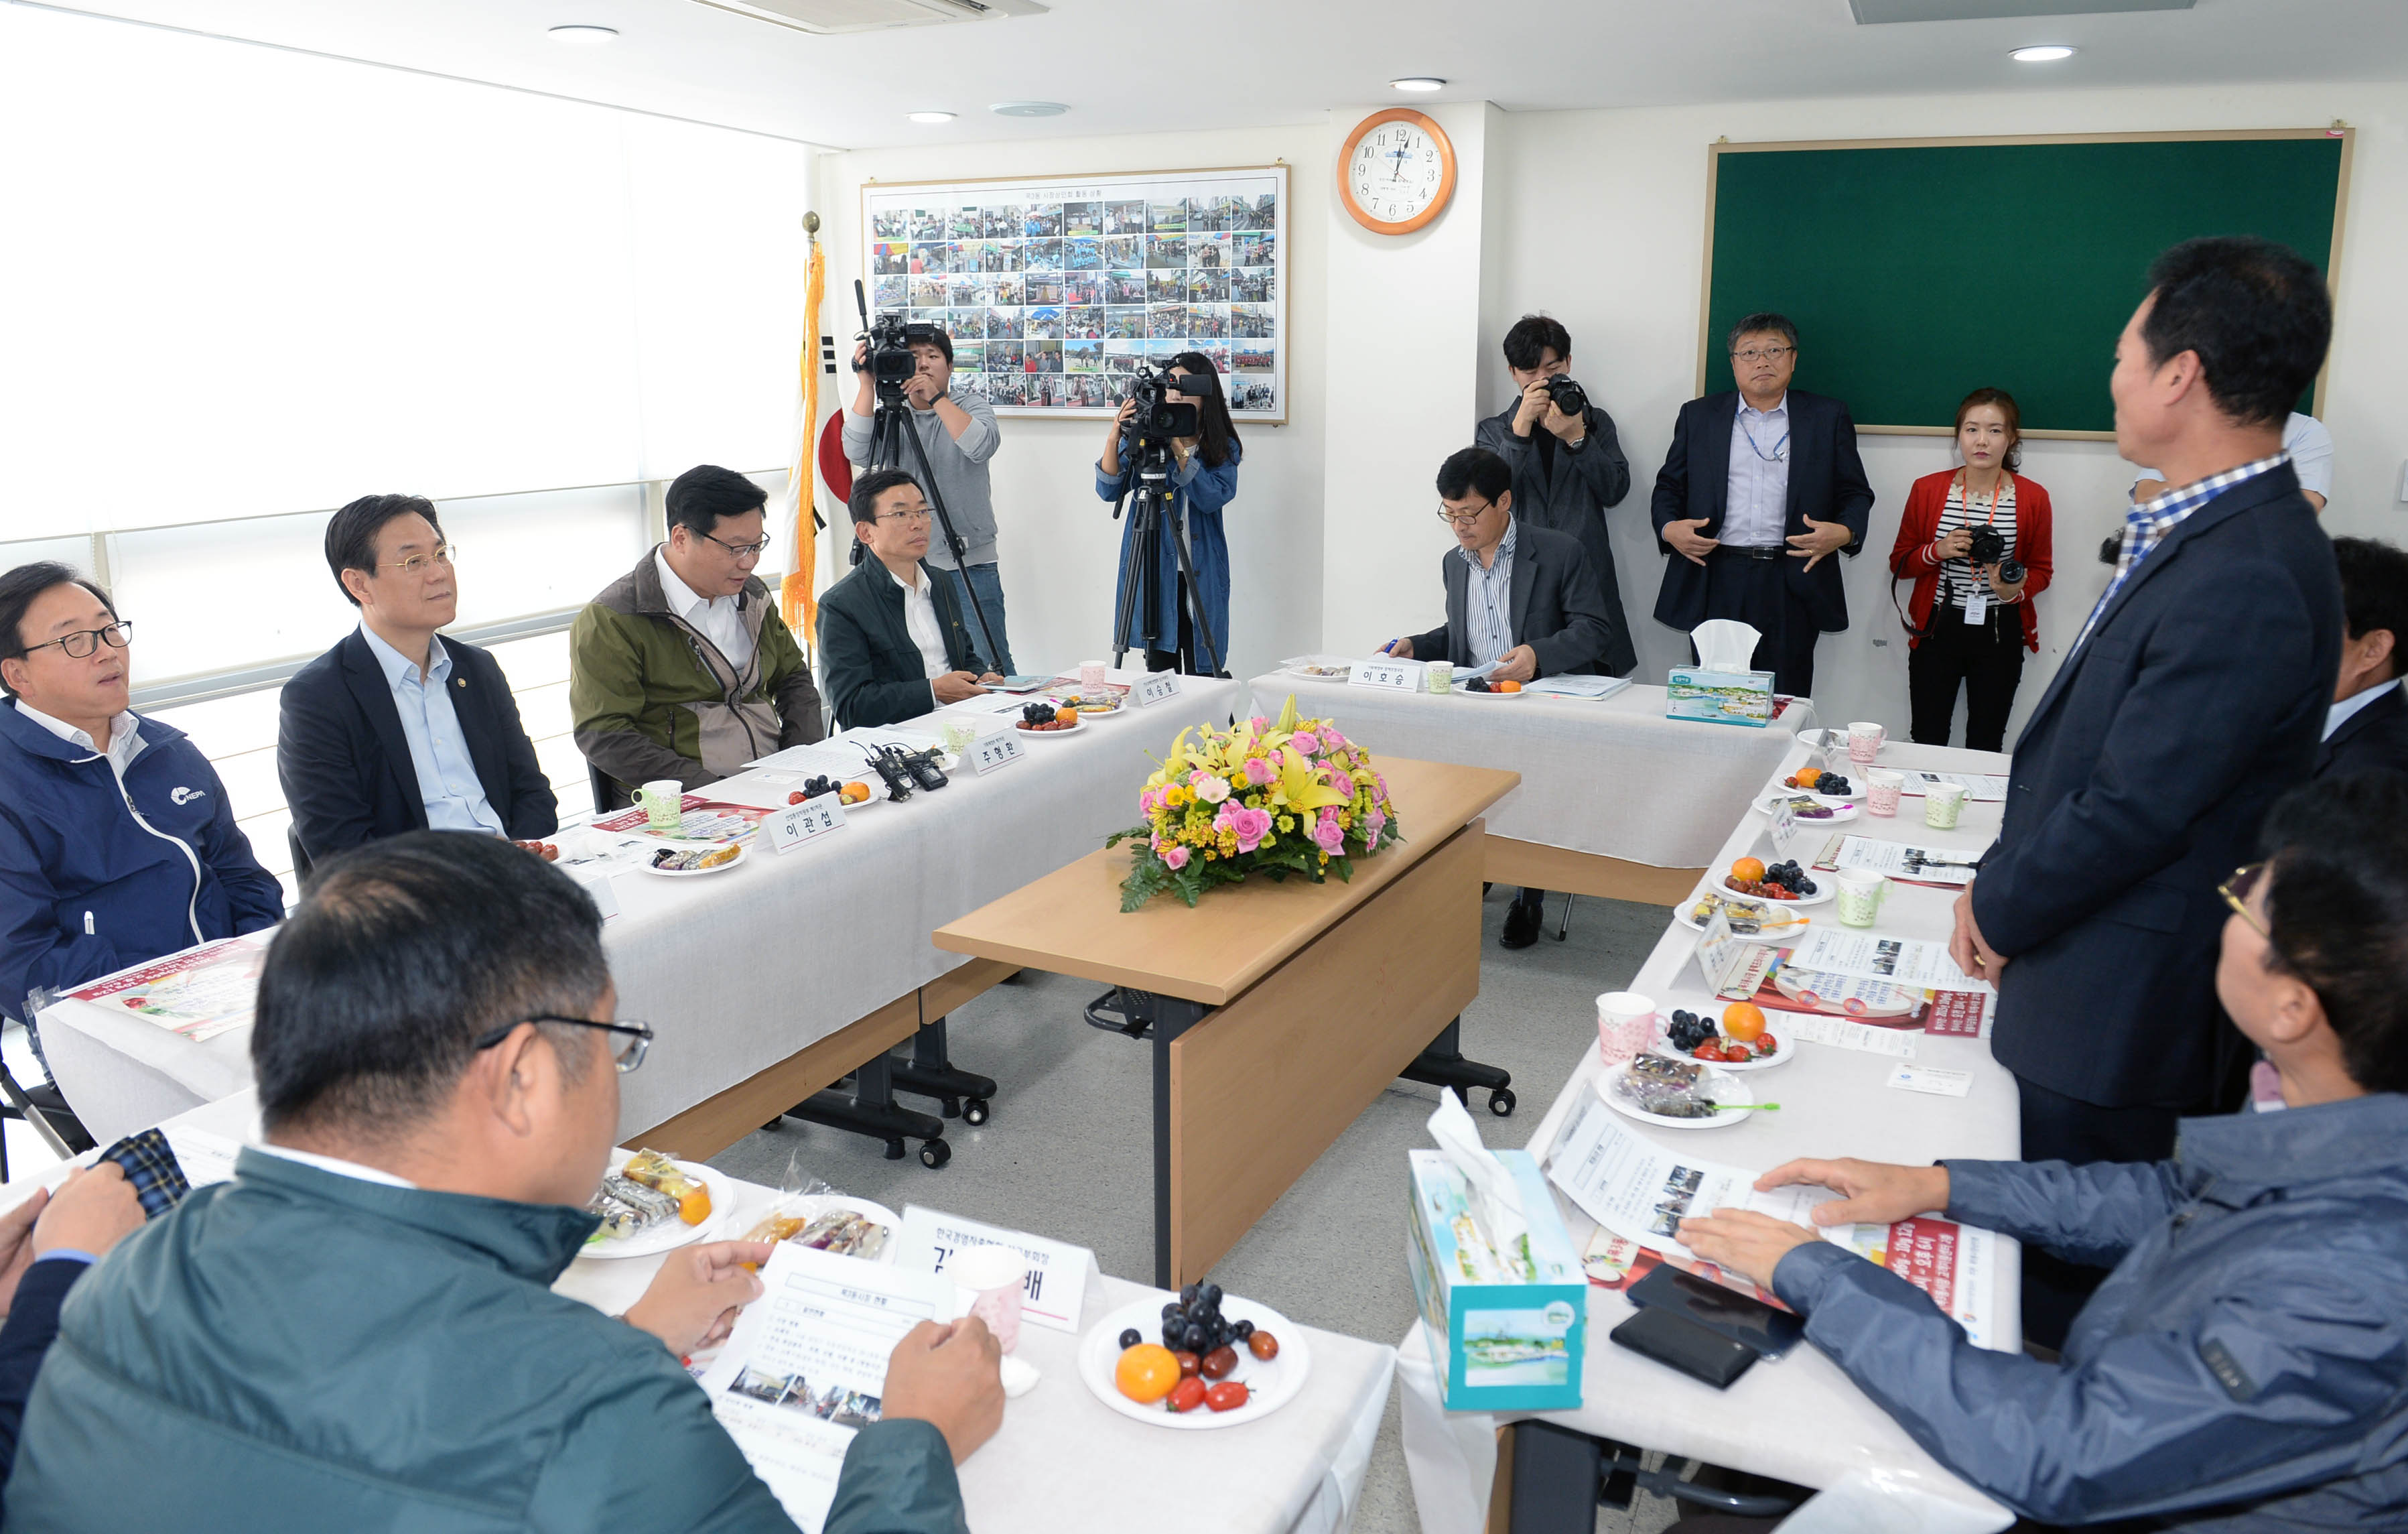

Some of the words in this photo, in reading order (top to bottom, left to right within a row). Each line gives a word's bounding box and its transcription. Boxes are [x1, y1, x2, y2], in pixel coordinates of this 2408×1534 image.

[1377, 133, 1386, 146] 11
[1395, 129, 1406, 141] 12
[1416, 136, 1420, 148] 1
[1363, 145, 1374, 158] 10
[1426, 150, 1434, 163] 2
[1358, 164, 1366, 176] 9
[1426, 170, 1434, 182] 3
[1361, 183, 1369, 196] 8
[1418, 188, 1427, 199] 4
[1372, 198, 1379, 210] 7
[1389, 204, 1396, 216] 6
[1406, 200, 1414, 213] 5
